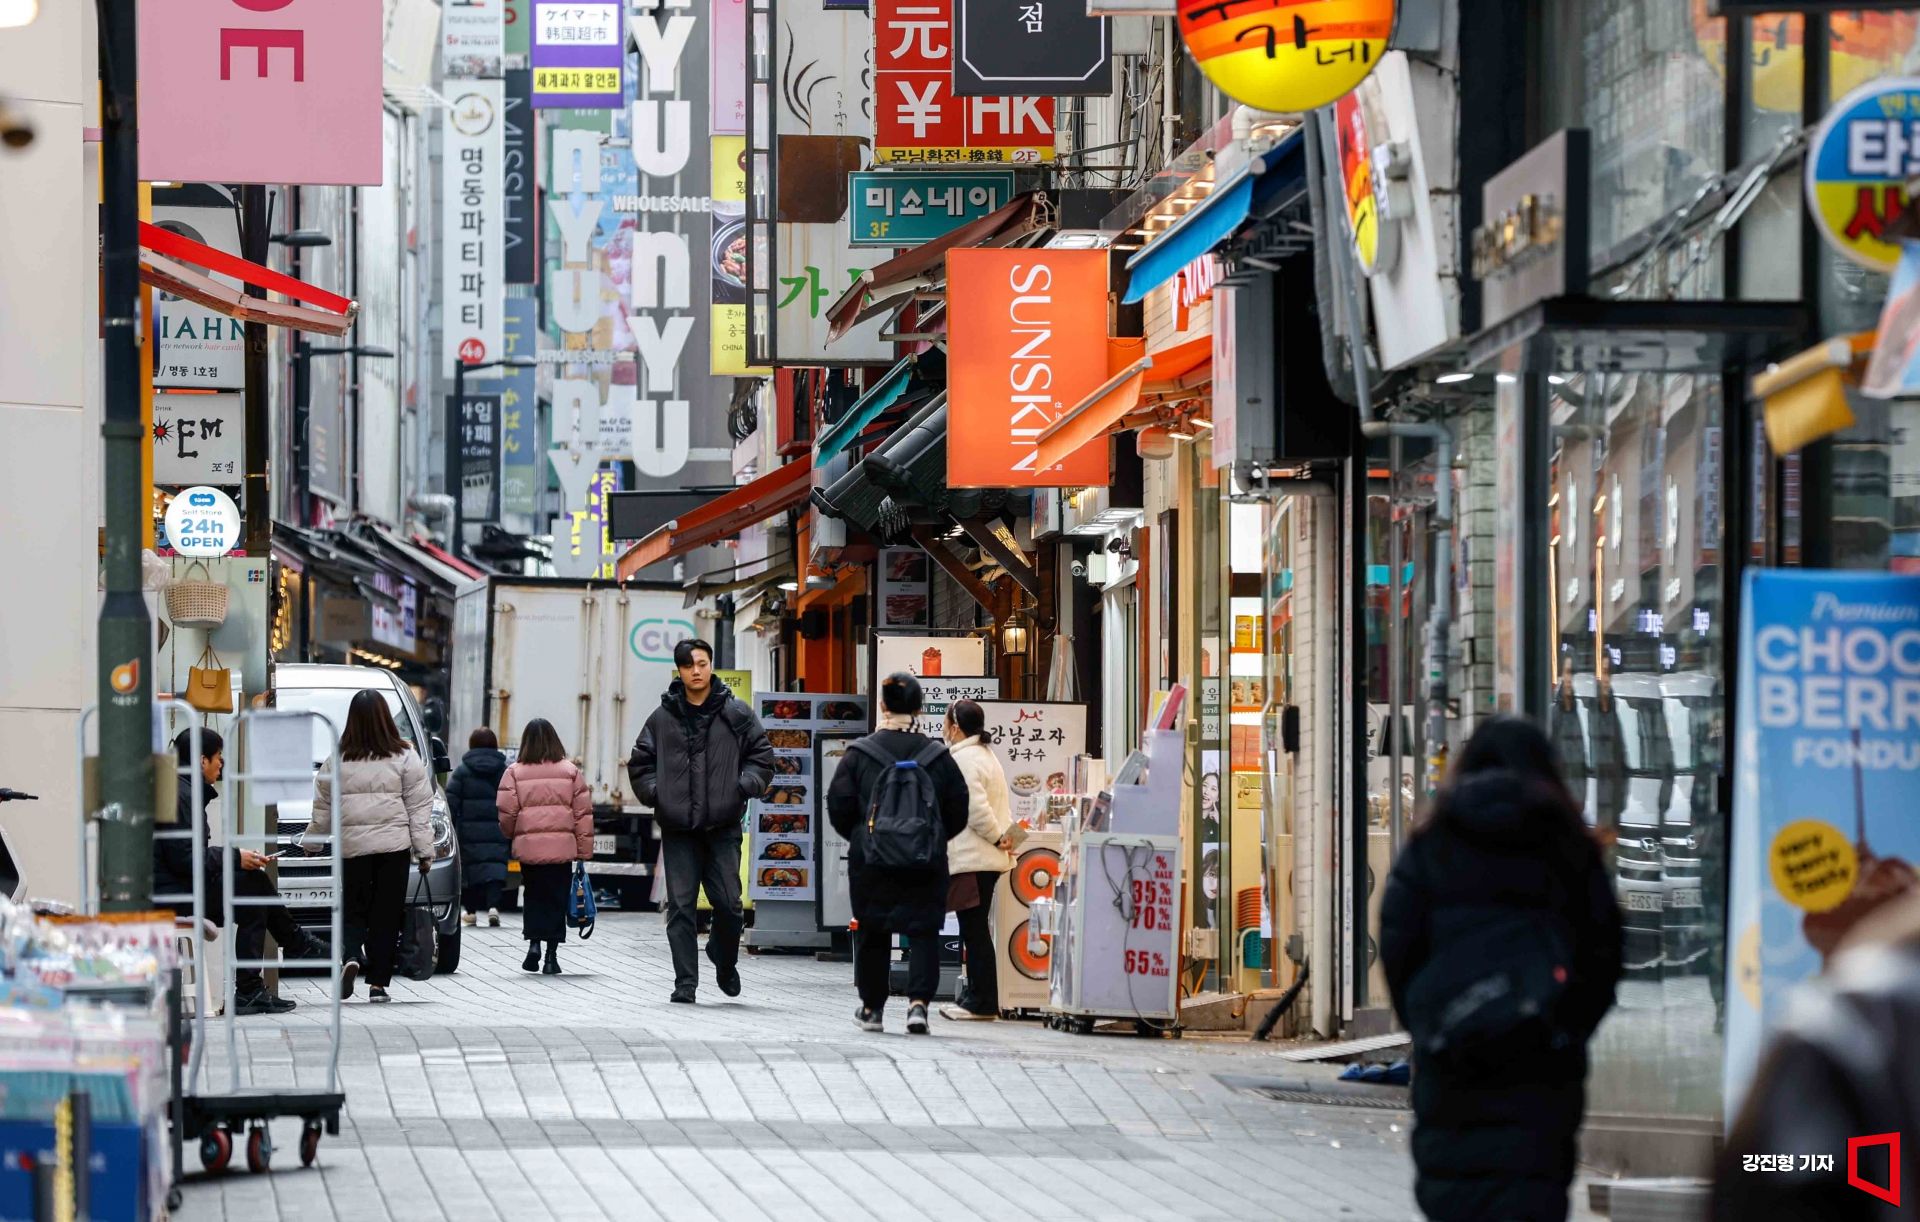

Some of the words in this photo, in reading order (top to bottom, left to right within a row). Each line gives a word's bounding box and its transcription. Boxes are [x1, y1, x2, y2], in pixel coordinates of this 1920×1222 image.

[546, 9, 611, 21] ケイマート
[1018, 2, 1043, 33] 점
[546, 26, 607, 41] 韩国超市
[888, 7, 948, 59] 元
[537, 73, 580, 88] 세계과자
[585, 73, 617, 88] 할인점
[896, 81, 941, 138] ¥
[972, 96, 1053, 134] HK
[1015, 151, 1038, 162] 2F
[612, 195, 711, 213] WHOLESALE
[870, 222, 890, 237] 3F
[460, 148, 485, 330] 명동파티파티
[169, 365, 188, 377] 명동
[193, 366, 217, 377] 1호점
[181, 519, 224, 534] 24h
[181, 537, 224, 547] OPEN
[990, 725, 1066, 746] 강남교자
[1008, 749, 1046, 762] 칼국수
